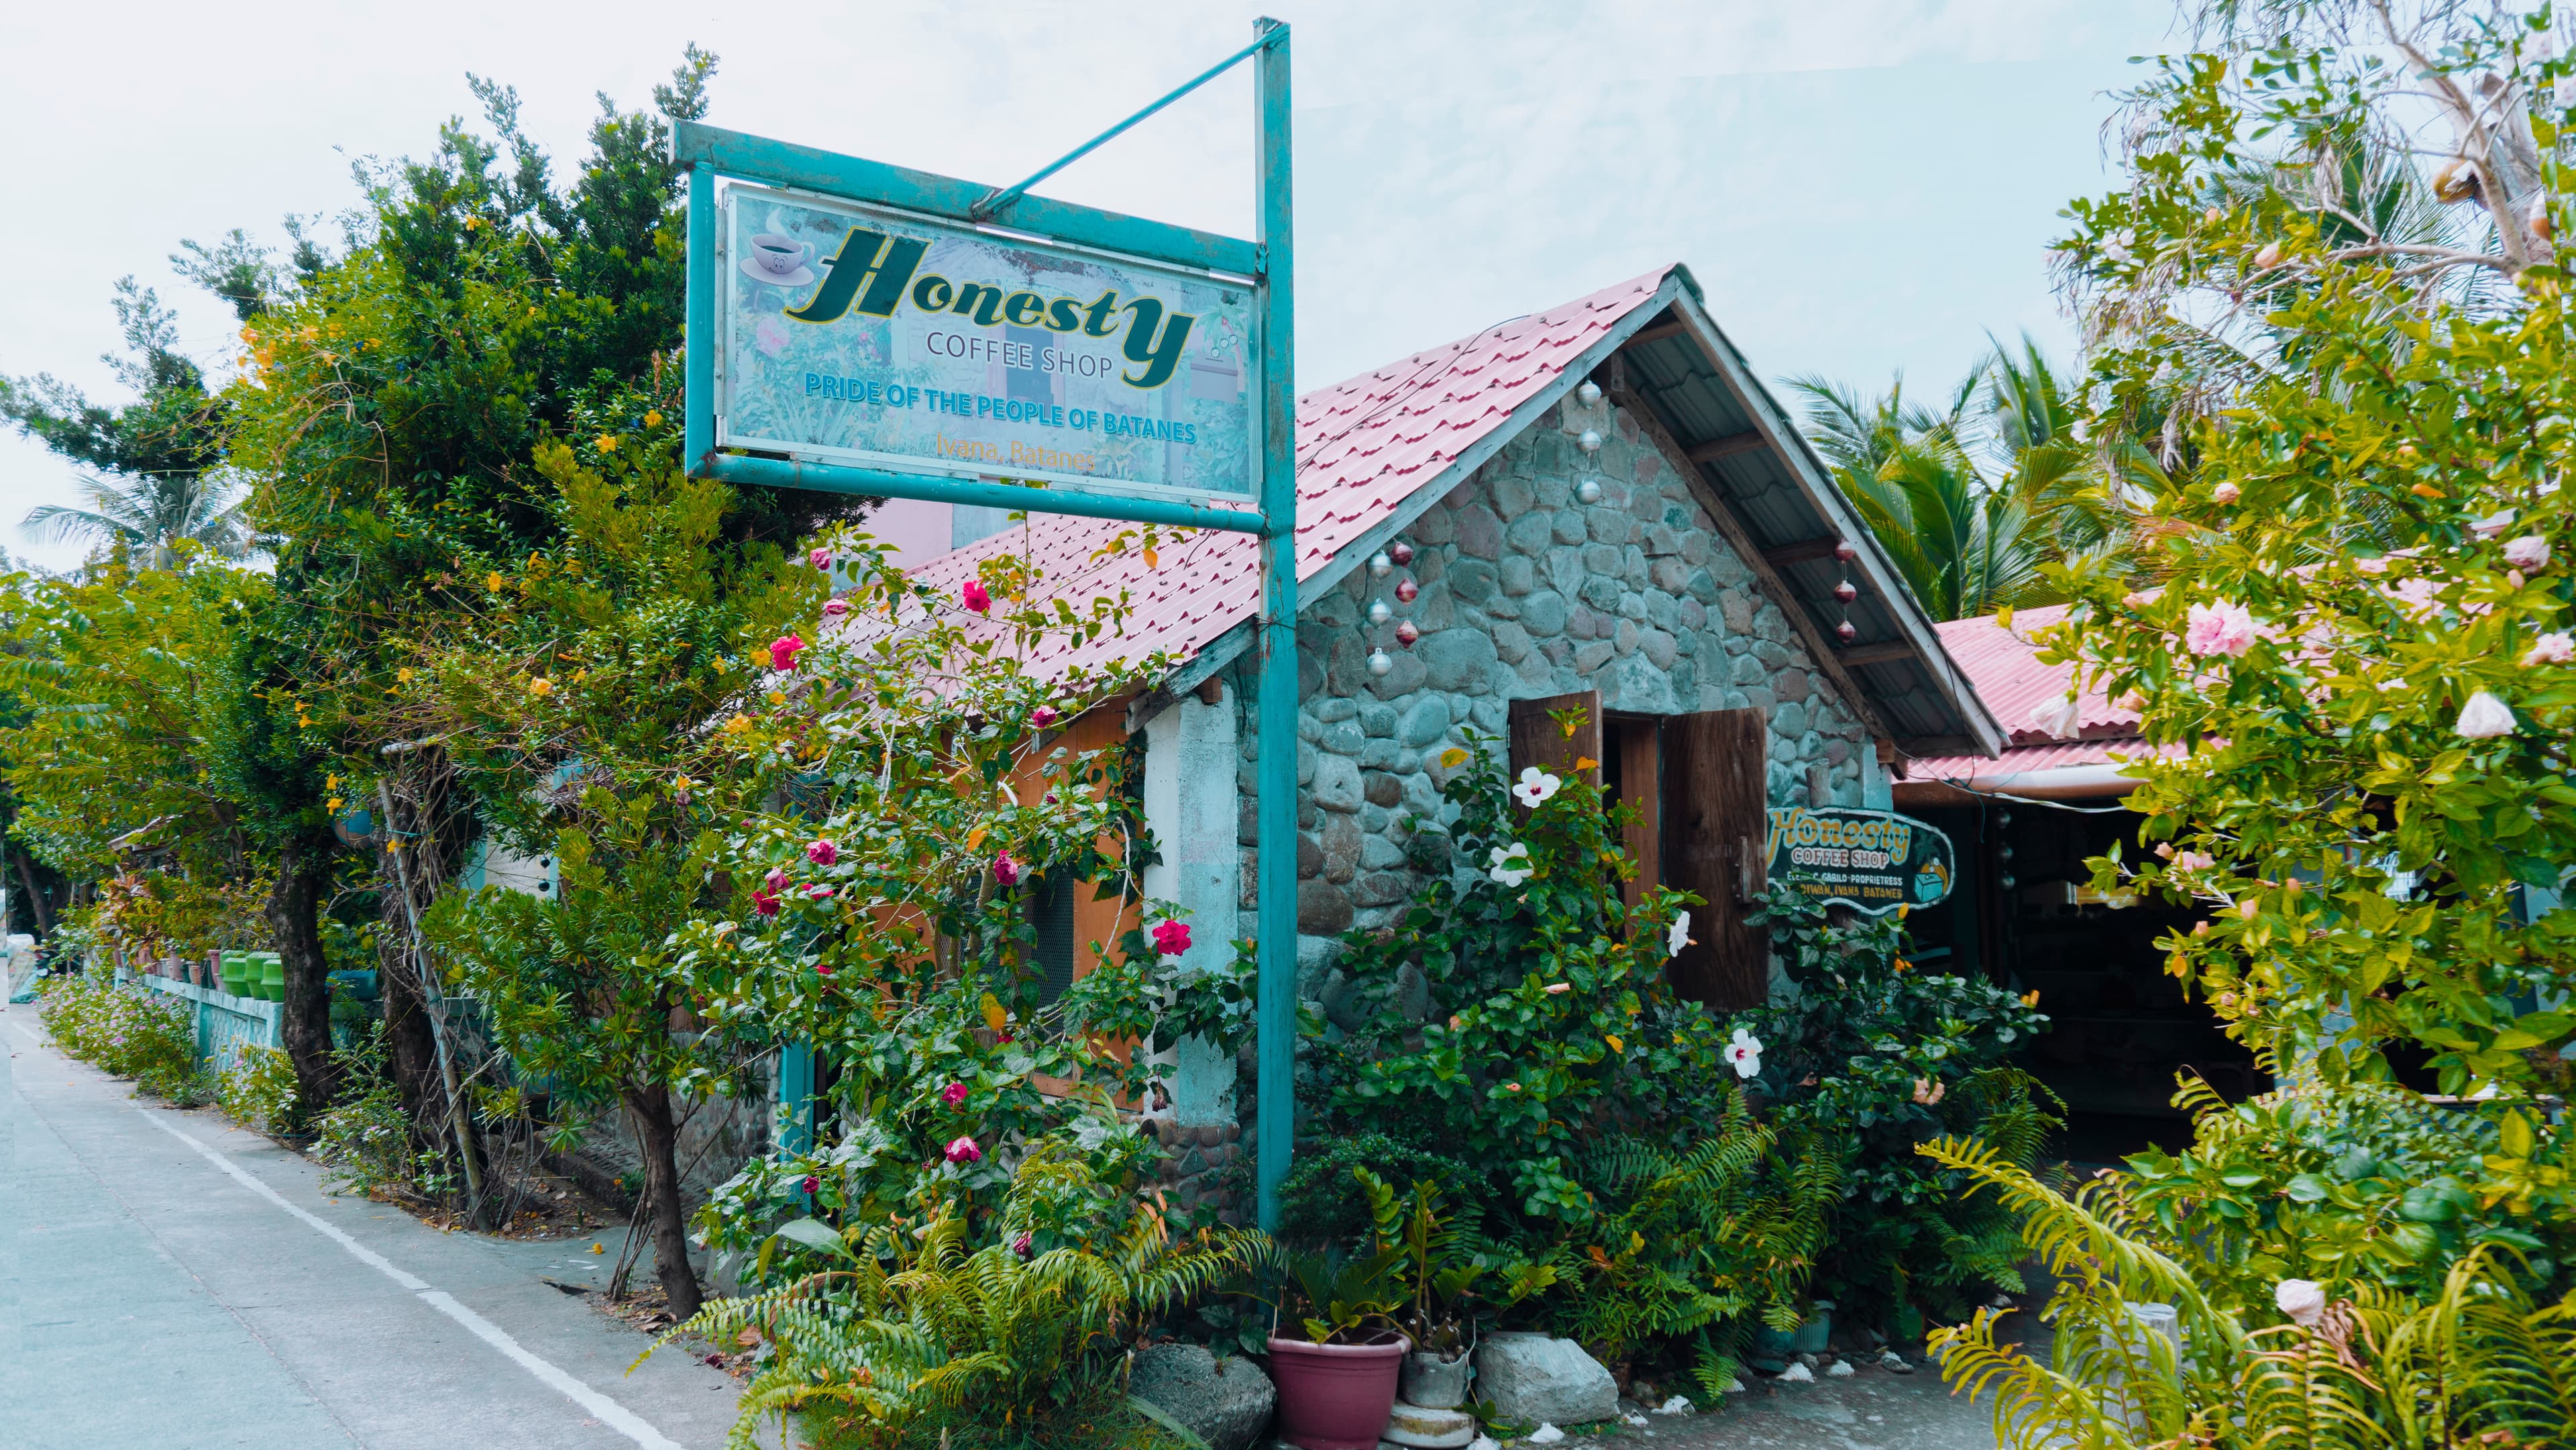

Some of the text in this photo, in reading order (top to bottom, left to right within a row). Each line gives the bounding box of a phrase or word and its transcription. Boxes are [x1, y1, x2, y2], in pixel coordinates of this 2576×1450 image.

[784, 225, 1197, 390] Honesty
[927, 331, 1113, 378] COFFEE SHOP
[805, 372, 1197, 444] PRIDE OF THE PEOPLE OF BATANES
[937, 431, 1096, 472] Ivana, Batanes
[1767, 806, 1911, 866] Honesty
[1792, 847, 1889, 870] COFFEE SHOP
